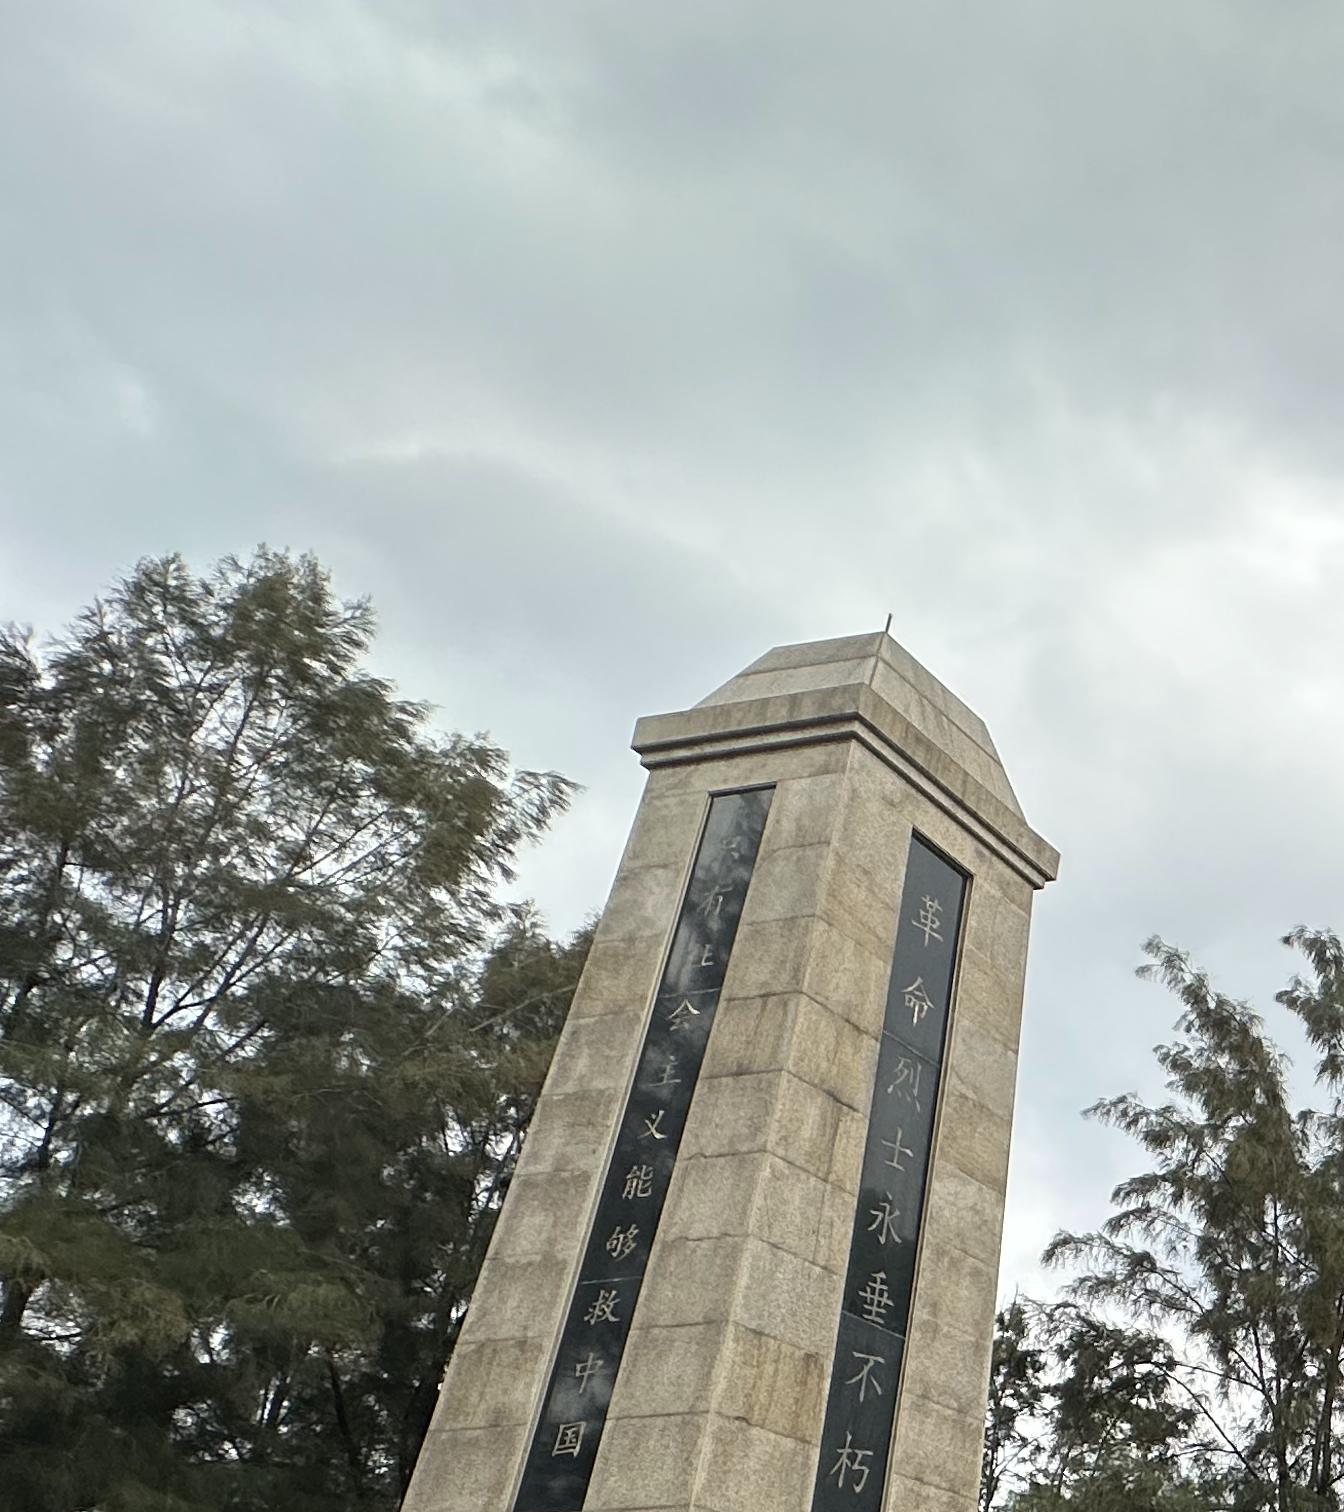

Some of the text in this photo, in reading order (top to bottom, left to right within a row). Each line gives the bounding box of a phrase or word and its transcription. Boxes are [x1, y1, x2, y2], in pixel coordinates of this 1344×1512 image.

[828, 894, 945, 1495] 革命烈士永垂不朽
